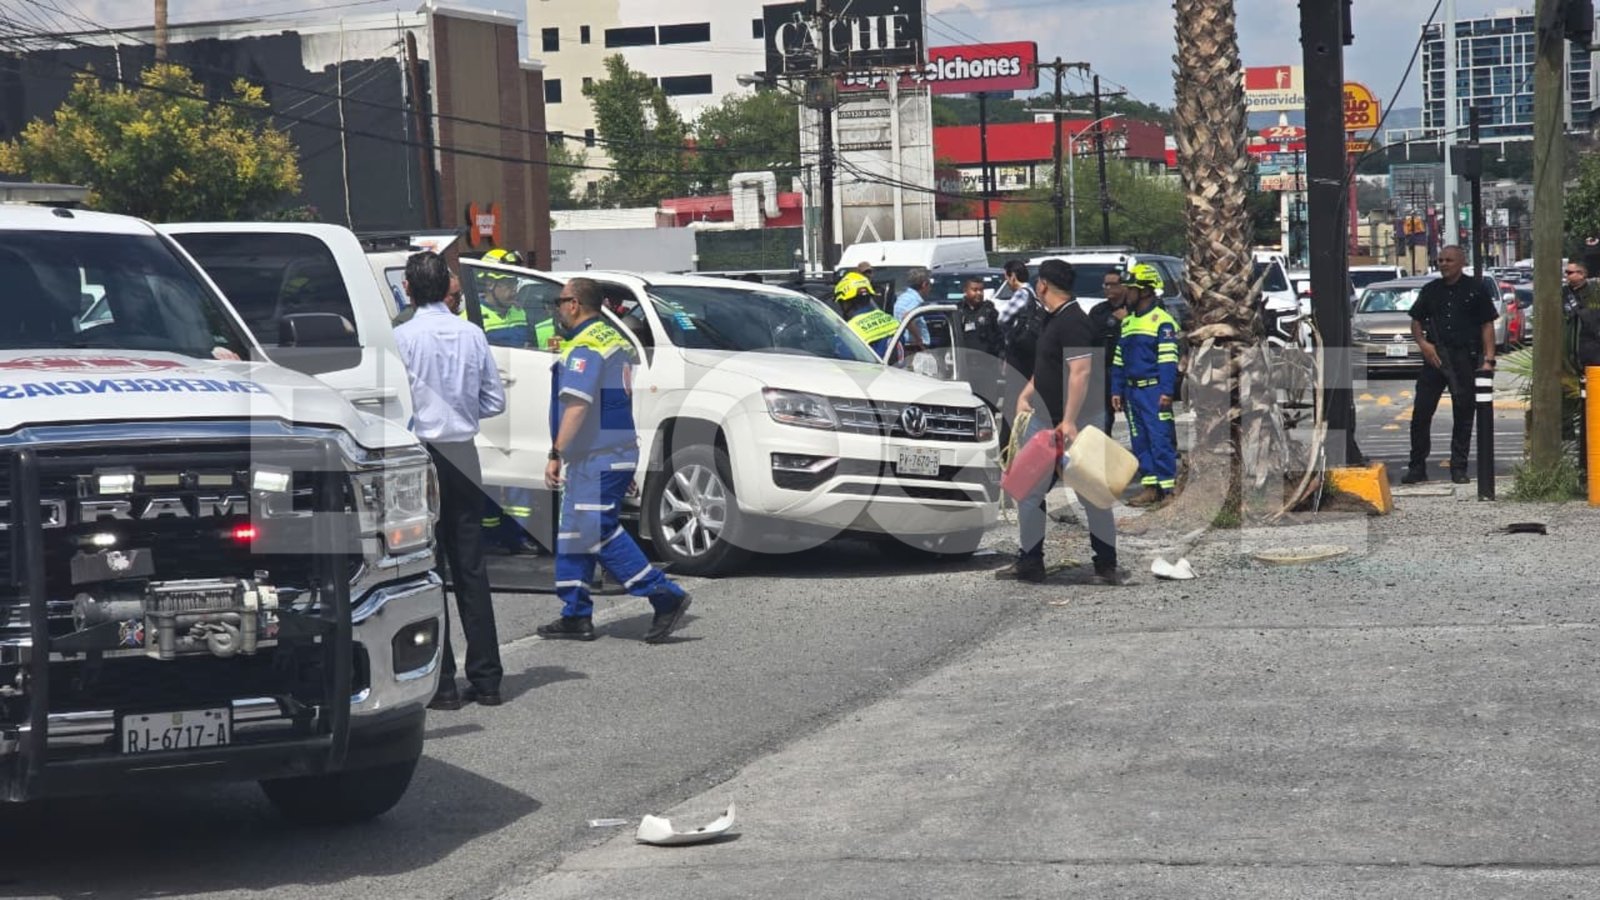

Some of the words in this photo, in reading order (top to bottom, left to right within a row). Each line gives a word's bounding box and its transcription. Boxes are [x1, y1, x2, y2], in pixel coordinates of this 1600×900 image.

[1245, 94, 1305, 105] benavide
[1270, 126, 1298, 137] 24
[80, 495, 249, 520] RAM
[128, 722, 226, 755] RJ-6717-A
